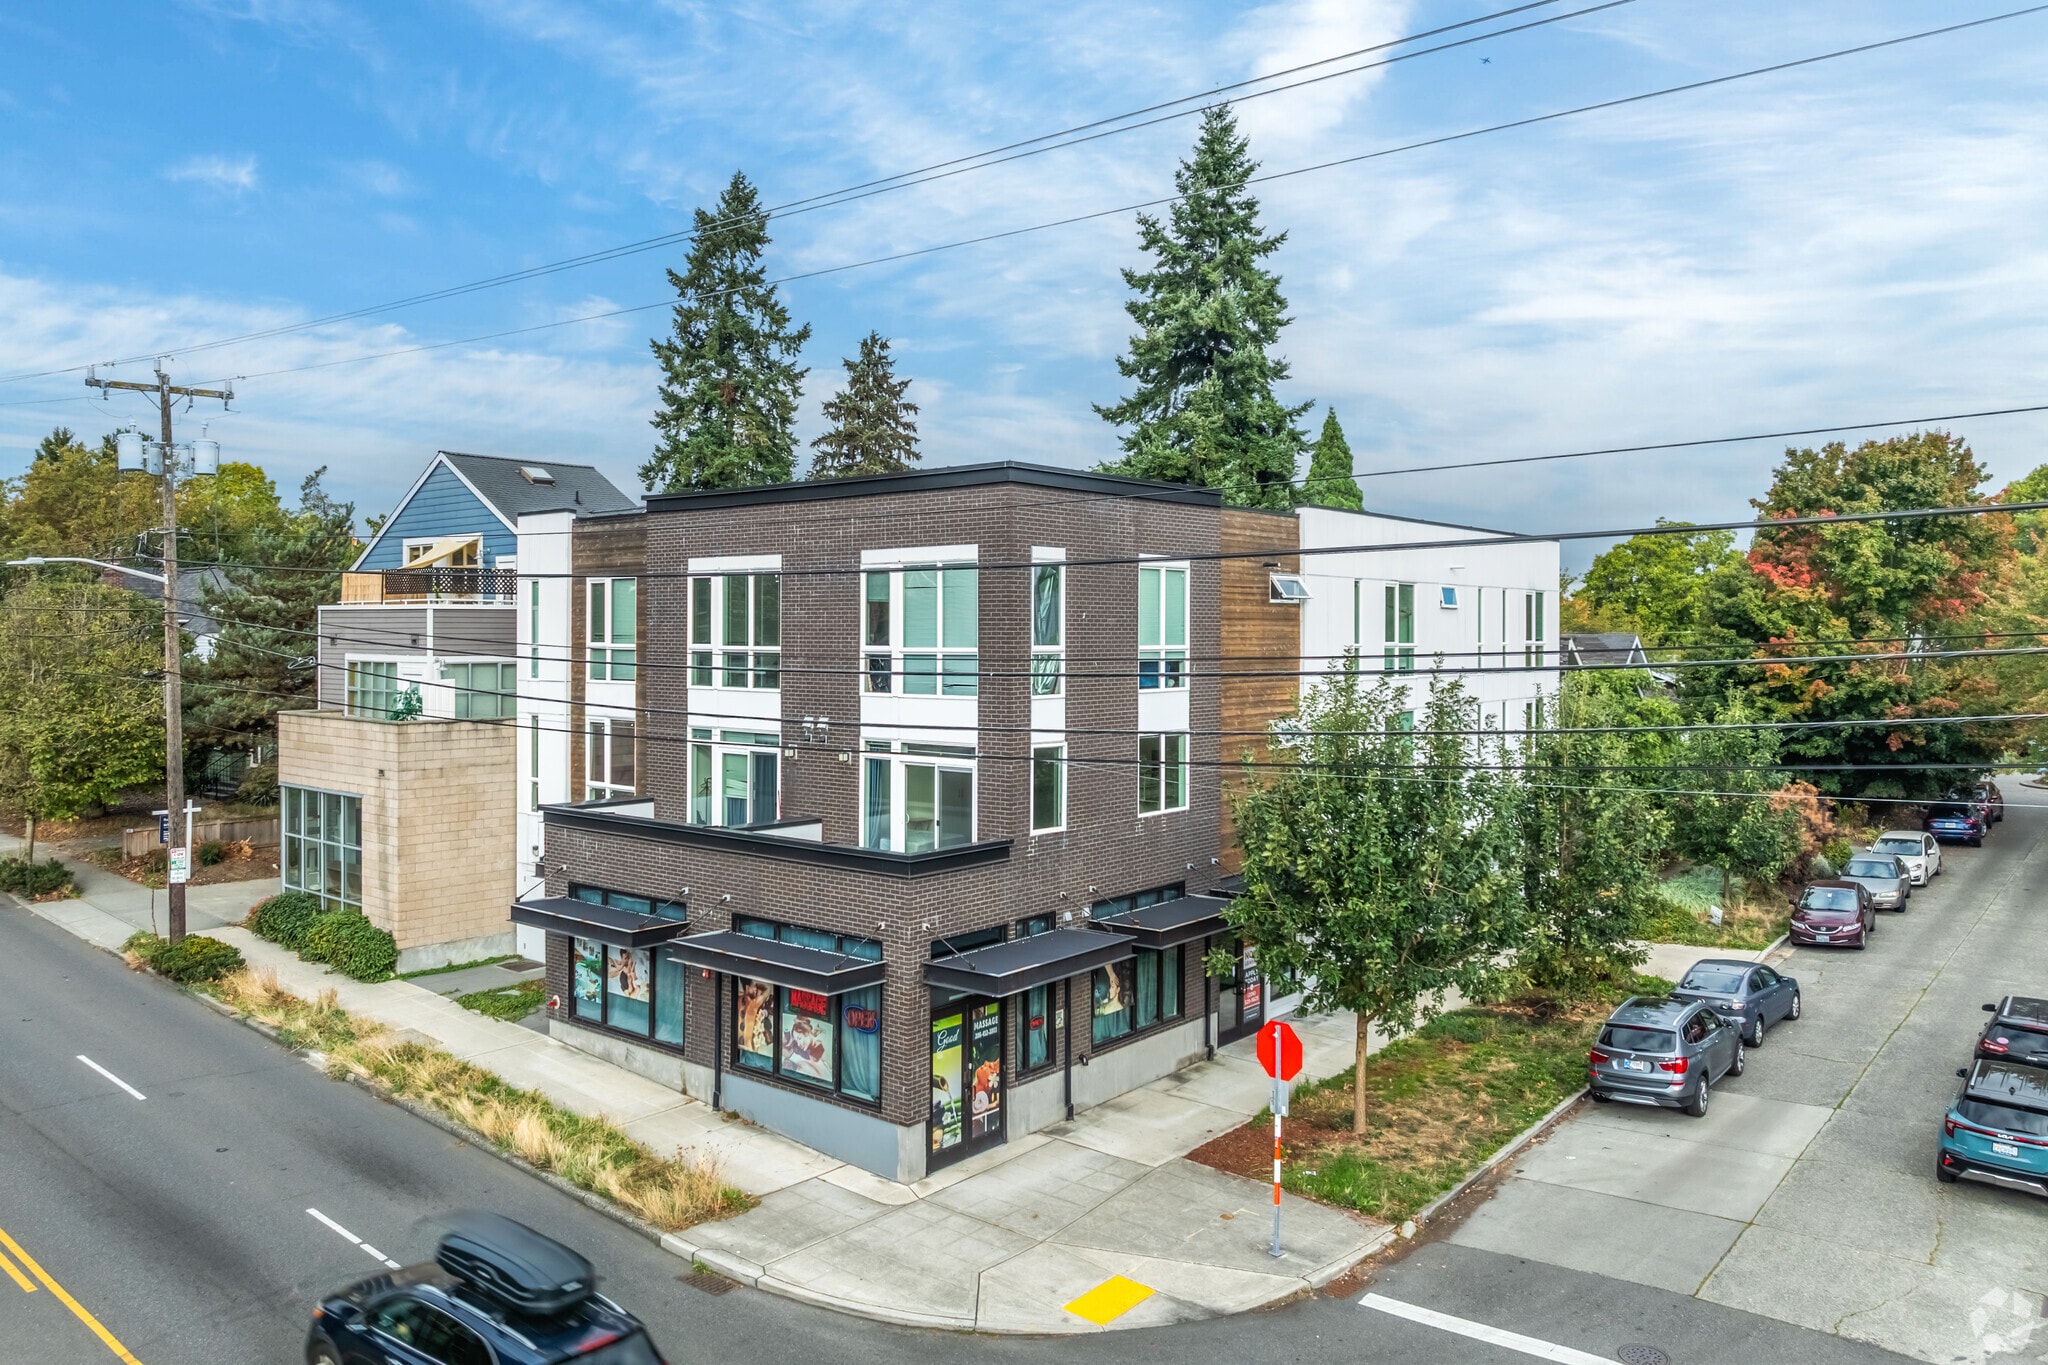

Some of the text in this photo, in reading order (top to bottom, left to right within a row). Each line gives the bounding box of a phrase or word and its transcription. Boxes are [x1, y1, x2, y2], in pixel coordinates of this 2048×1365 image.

[790, 989, 827, 1015] MASSAGE
[847, 1010, 876, 1029] OPEN
[973, 1016, 999, 1031] MASSAGE
[937, 1029, 960, 1053] Good
